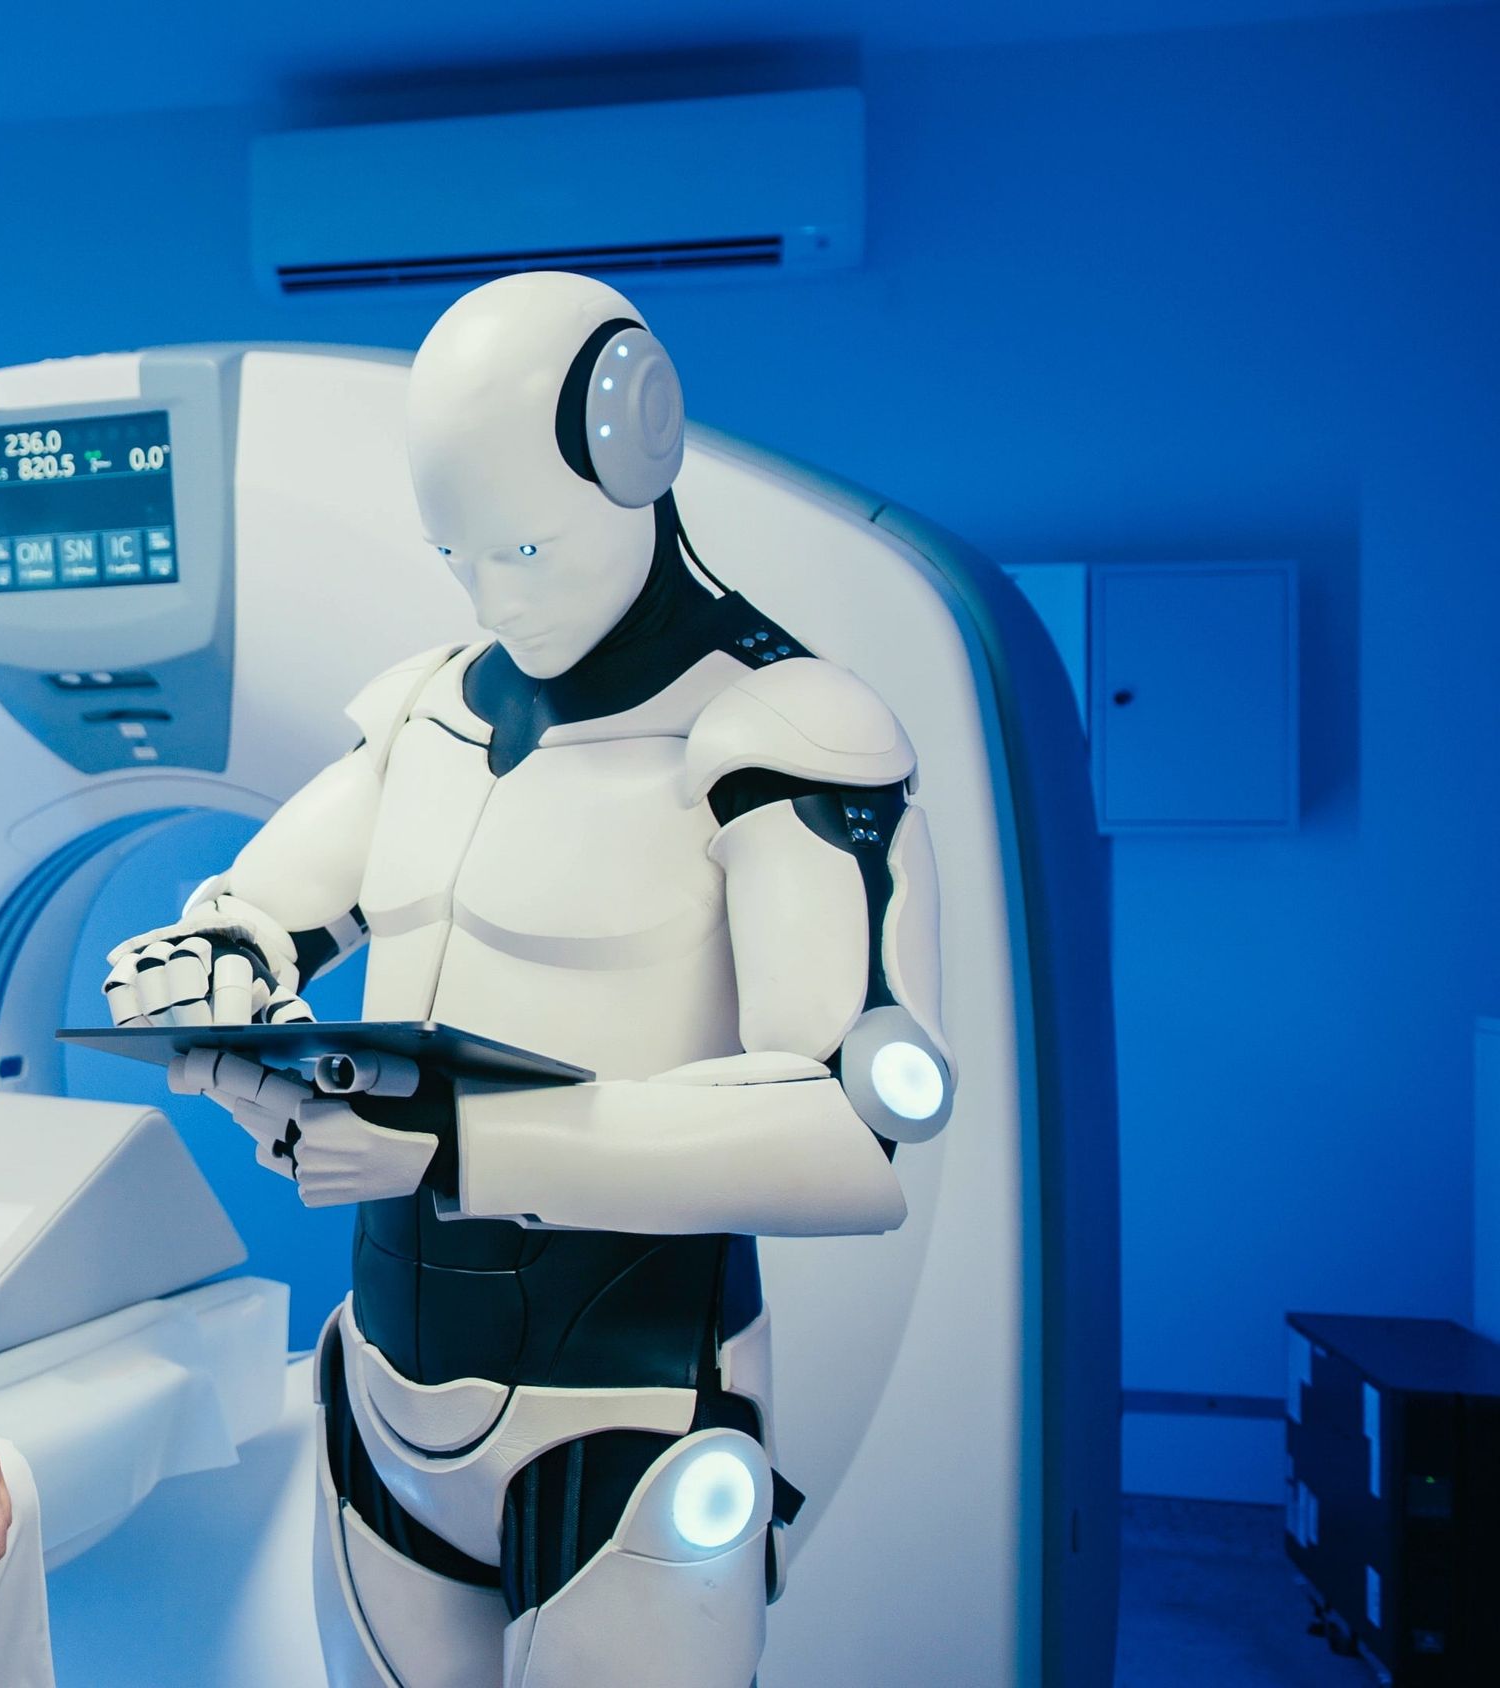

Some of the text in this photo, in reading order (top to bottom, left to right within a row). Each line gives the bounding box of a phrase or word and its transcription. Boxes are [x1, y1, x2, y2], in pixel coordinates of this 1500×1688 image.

[4, 430, 61, 457] 236.0
[18, 453, 75, 480] 820.5
[64, 538, 93, 562] SN
[111, 535, 133, 559] IC
